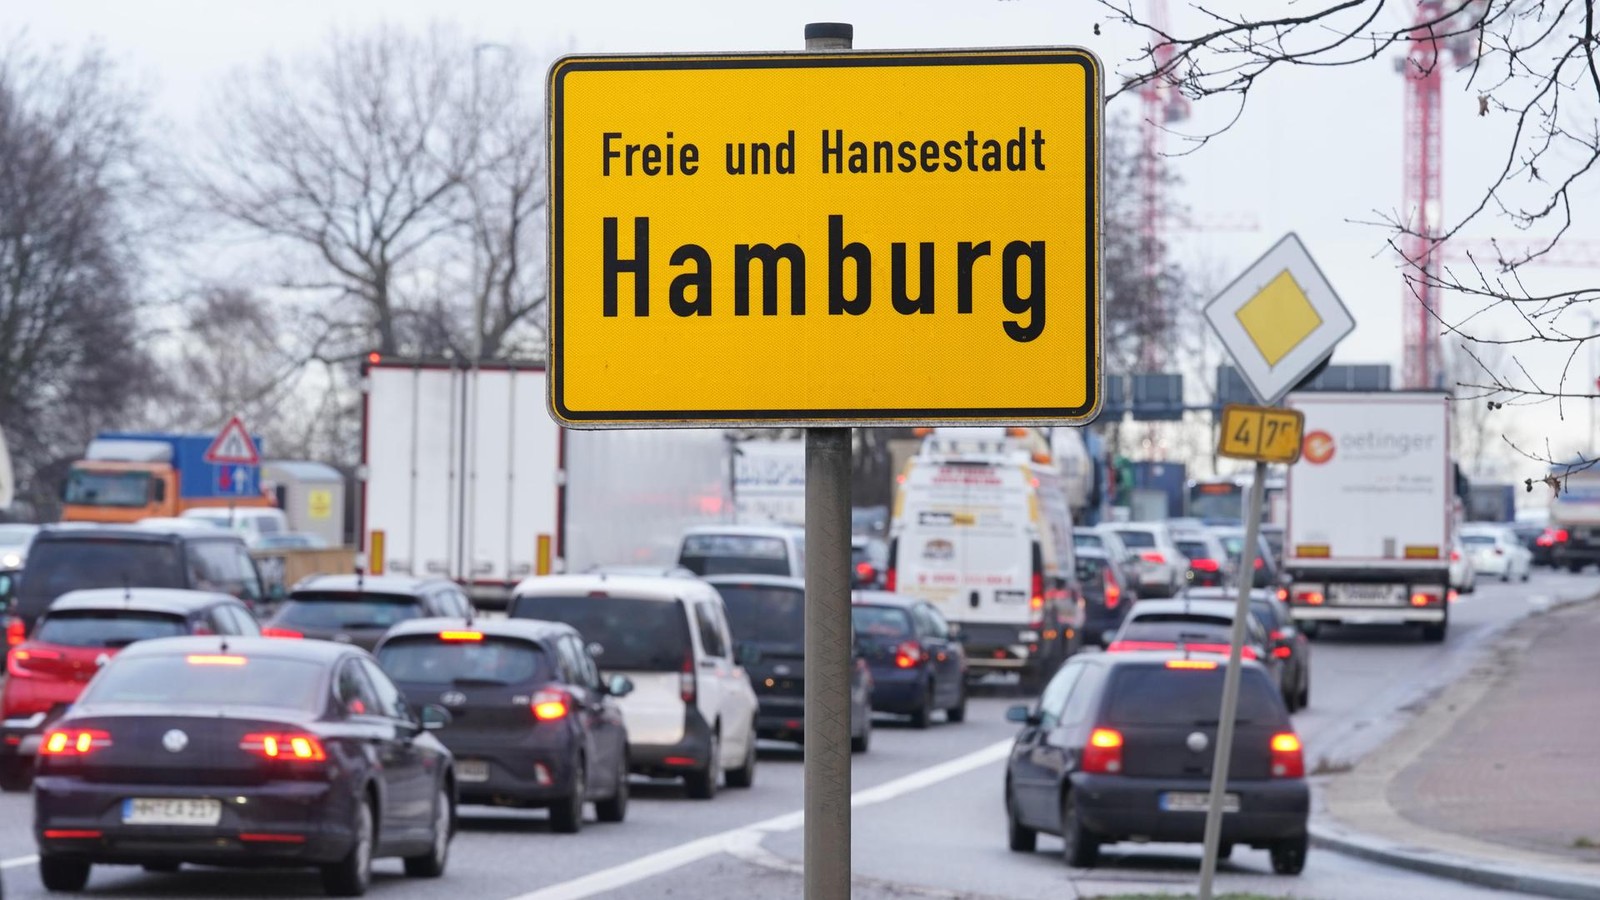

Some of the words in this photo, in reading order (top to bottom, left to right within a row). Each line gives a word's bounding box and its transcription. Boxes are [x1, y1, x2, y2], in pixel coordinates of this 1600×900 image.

[604, 132, 698, 176] Freie
[726, 131, 794, 175] und
[823, 127, 1045, 173] Hansestadt
[604, 215, 1045, 342] Hamburg
[1234, 417, 1250, 447] 4
[1341, 431, 1435, 457] oetinger
